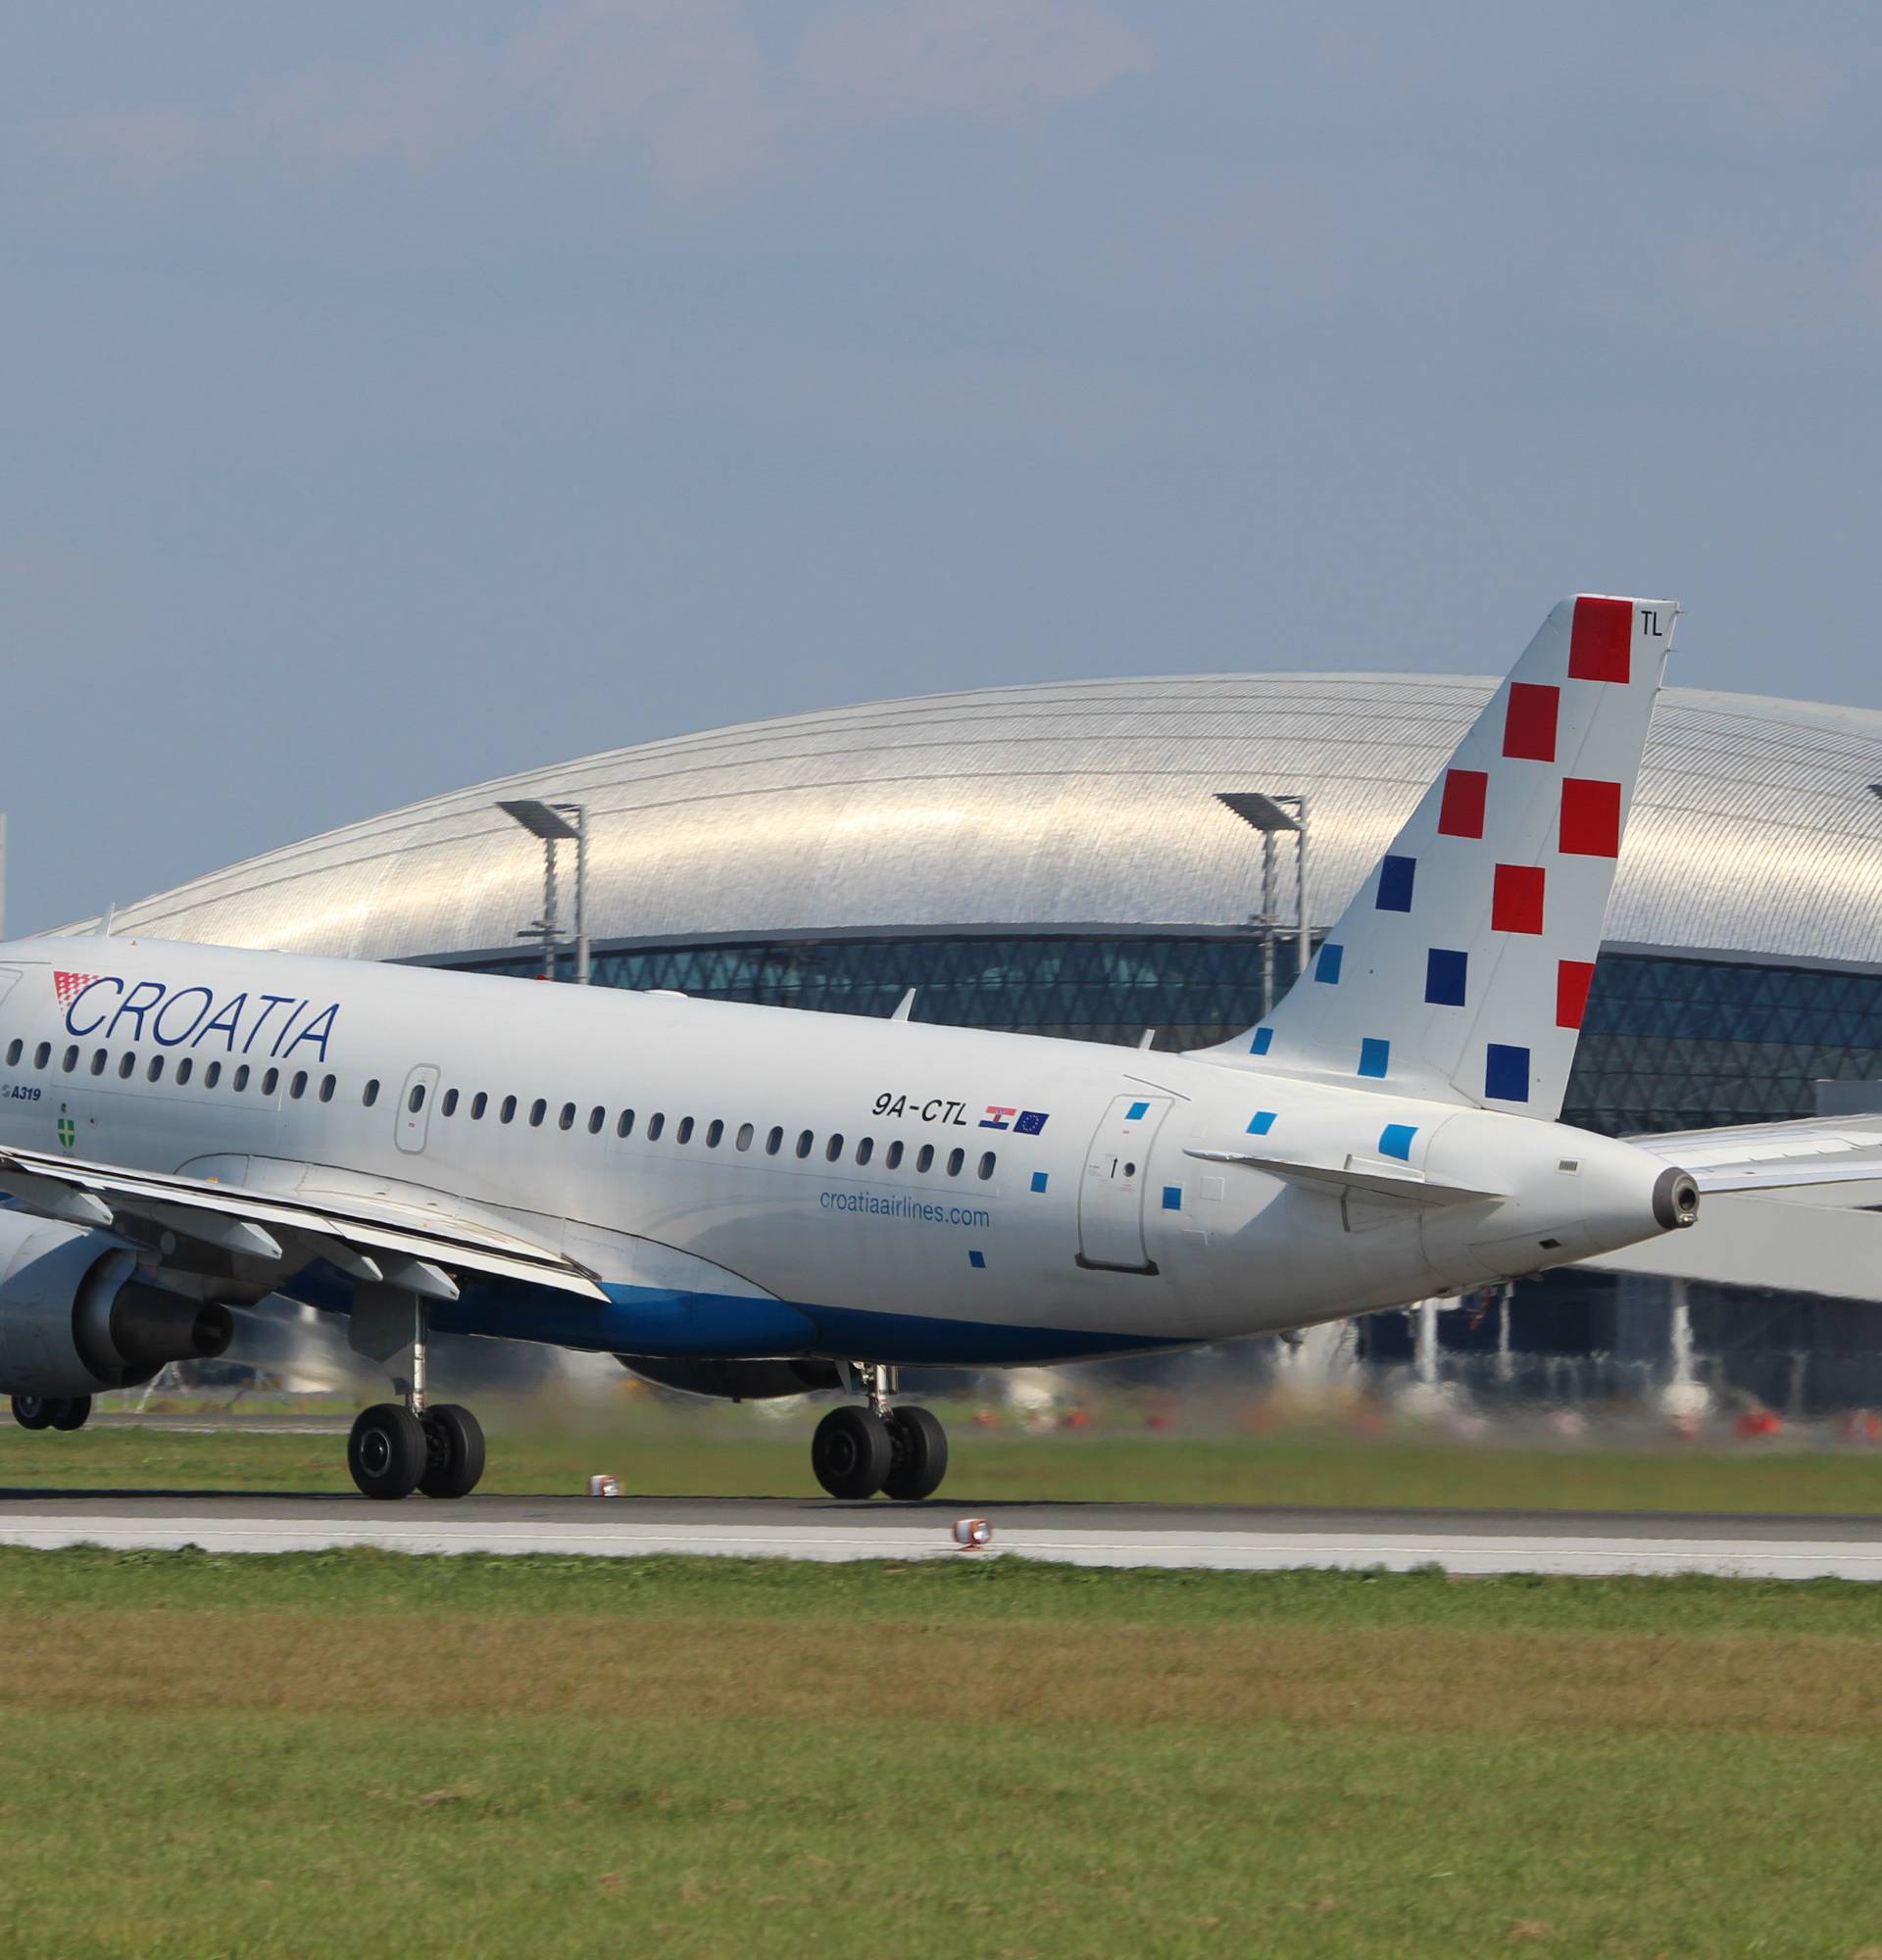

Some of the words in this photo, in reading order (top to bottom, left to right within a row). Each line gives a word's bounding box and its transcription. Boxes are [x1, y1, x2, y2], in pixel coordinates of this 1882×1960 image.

[1641, 611, 1662, 637] TL
[65, 976, 341, 1063] CROATIA
[10, 1085, 41, 1102] A319
[871, 1092, 968, 1126] 9A-CTL
[819, 1189, 990, 1229] croatiaairlines.com
